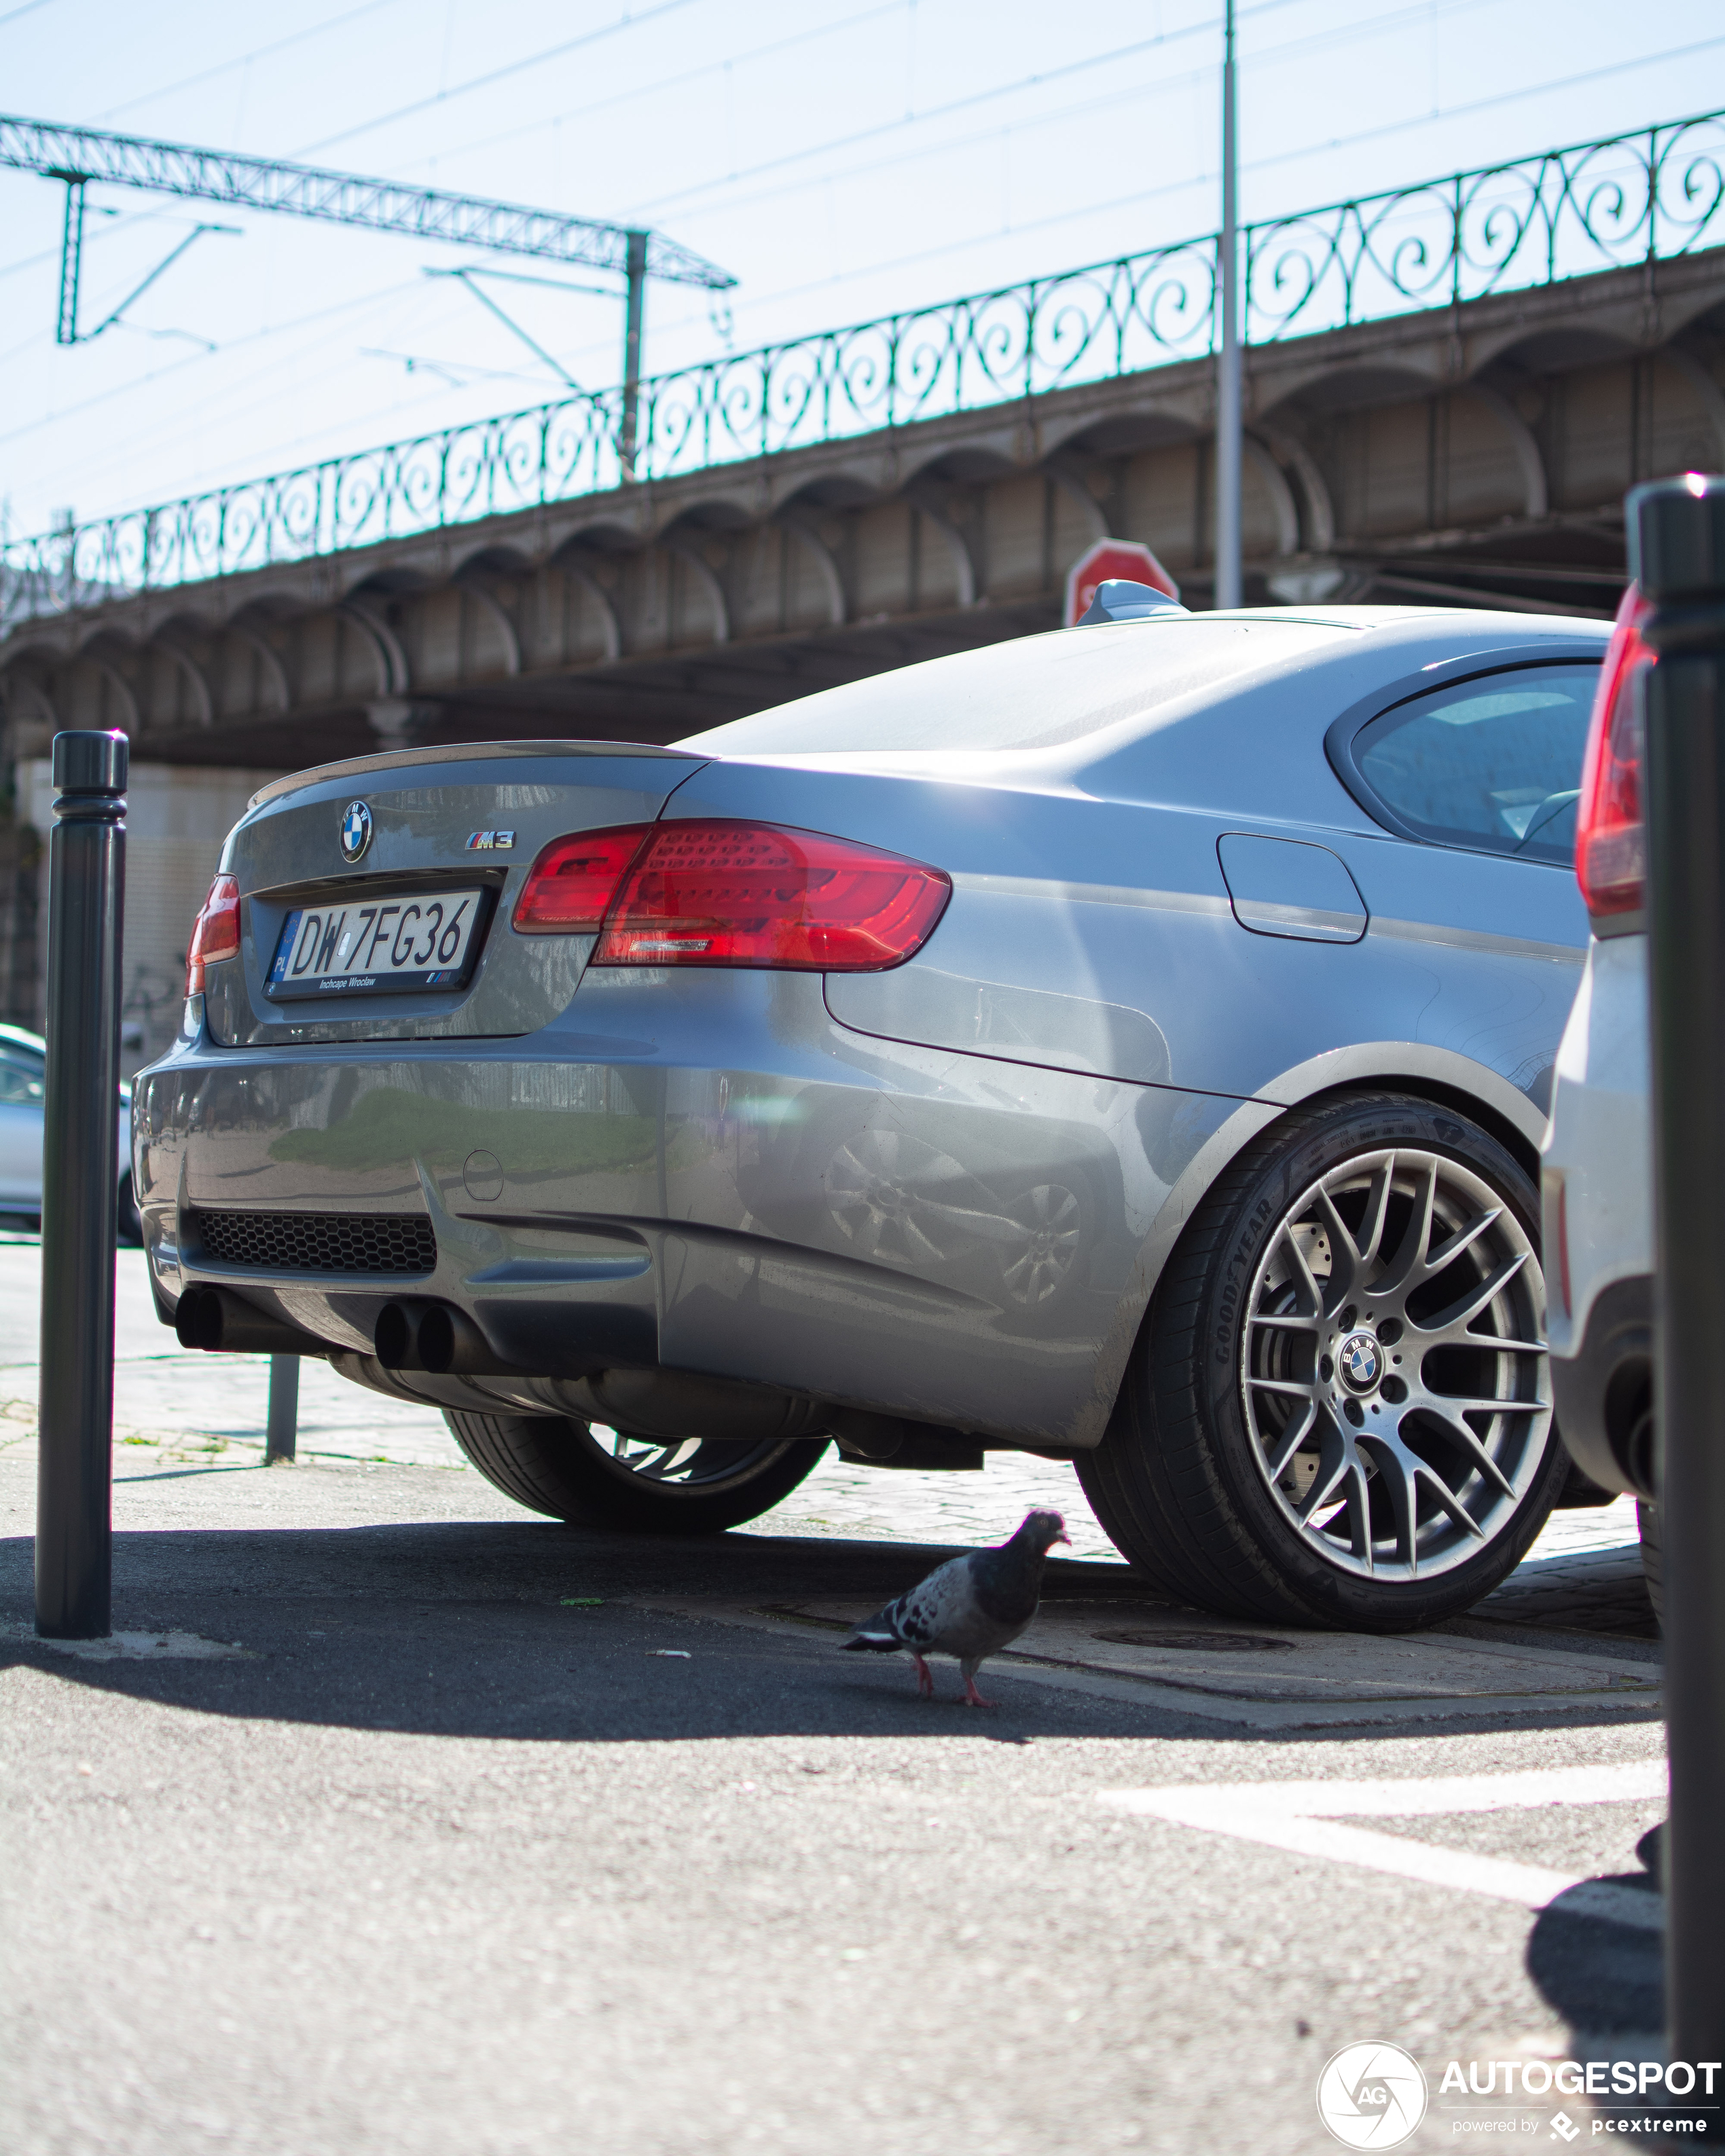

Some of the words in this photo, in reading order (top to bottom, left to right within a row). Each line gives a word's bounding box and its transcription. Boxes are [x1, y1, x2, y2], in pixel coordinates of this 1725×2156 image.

[475, 830, 516, 849] M3
[291, 911, 346, 975] DW
[345, 900, 470, 970] 7FG36
[273, 956, 286, 972] PL
[319, 979, 347, 989] Inchcape
[1215, 1198, 1274, 1365] GOODYEAR
[1343, 1338, 1375, 1364] BMW
